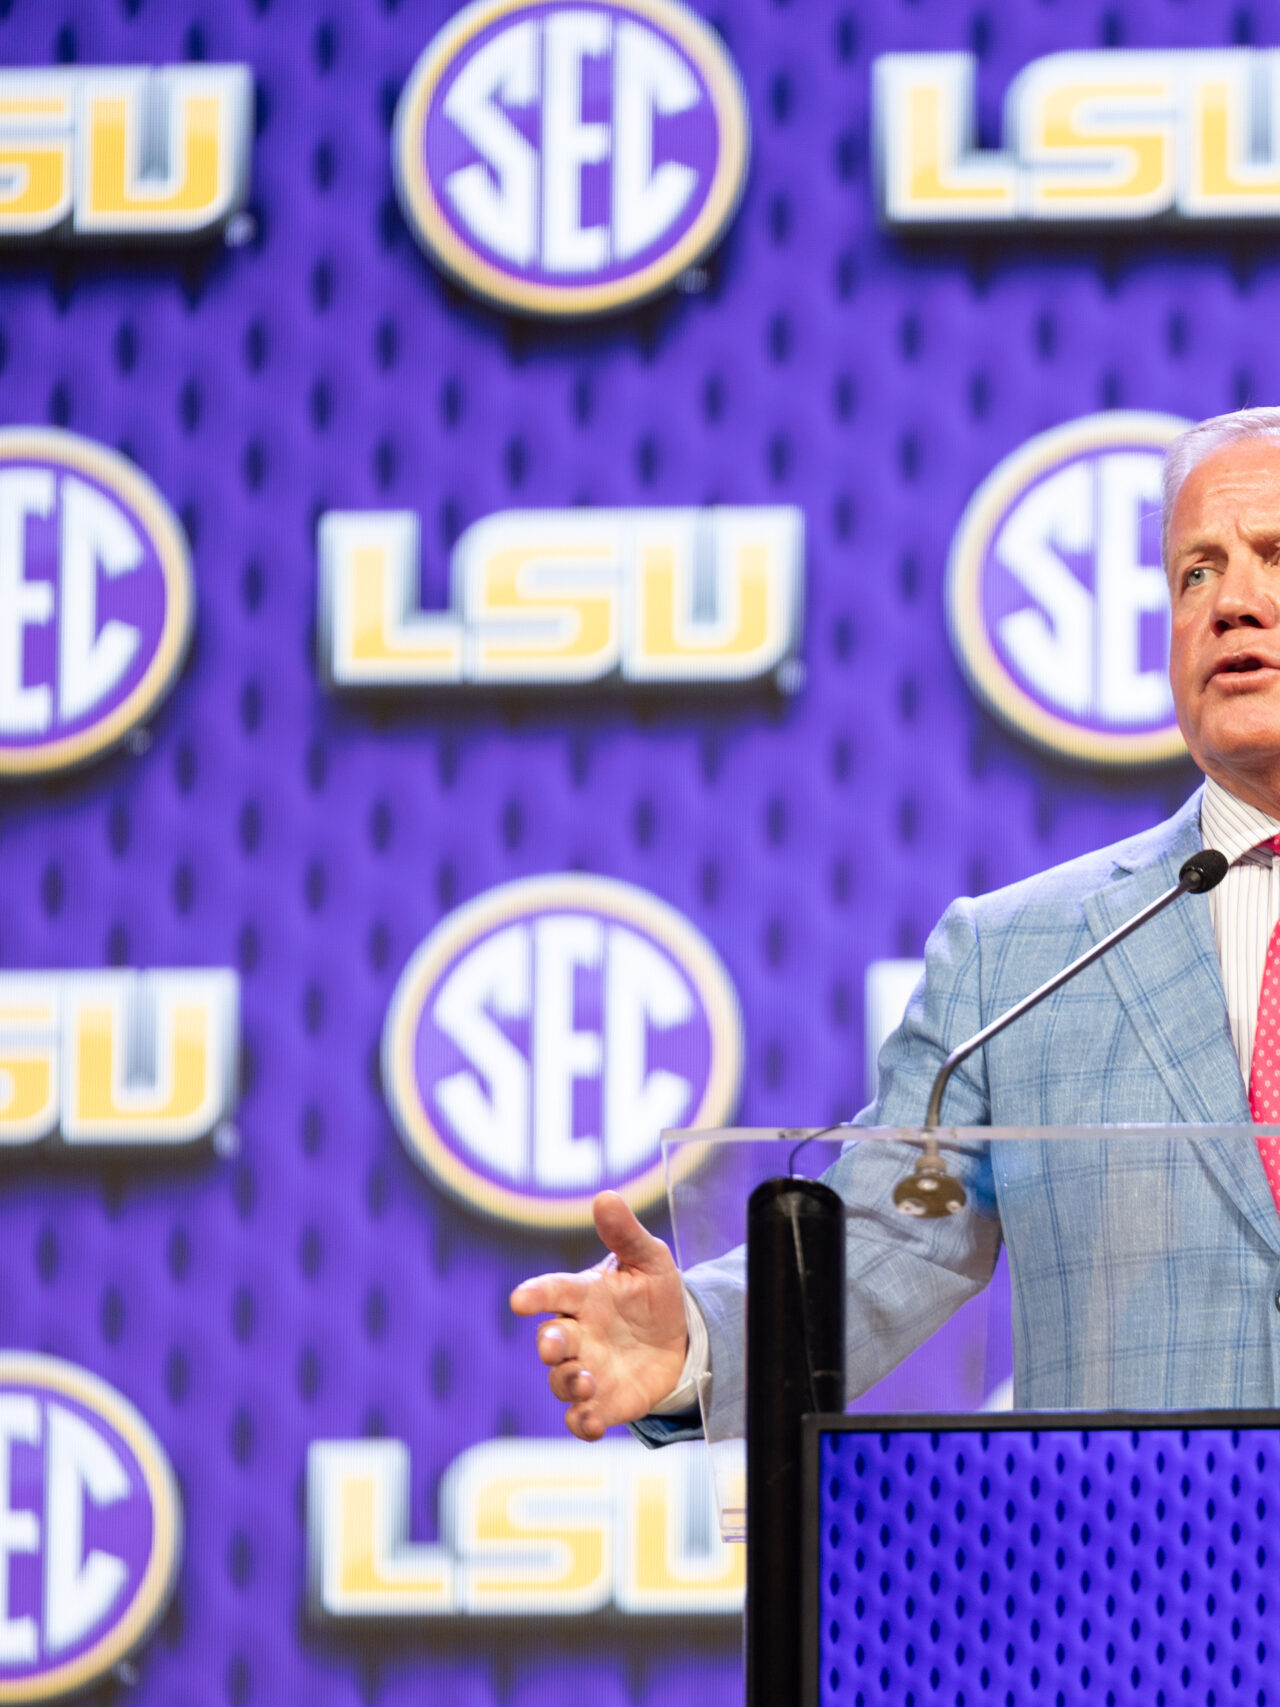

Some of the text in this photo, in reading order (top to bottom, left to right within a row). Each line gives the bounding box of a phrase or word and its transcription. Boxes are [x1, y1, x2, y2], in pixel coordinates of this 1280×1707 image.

[443, 12, 703, 274] SEC
[319, 507, 805, 683] LSU
[996, 452, 1172, 722] SE
[432, 913, 693, 1190] SEC
[308, 1438, 747, 1616] LSU
